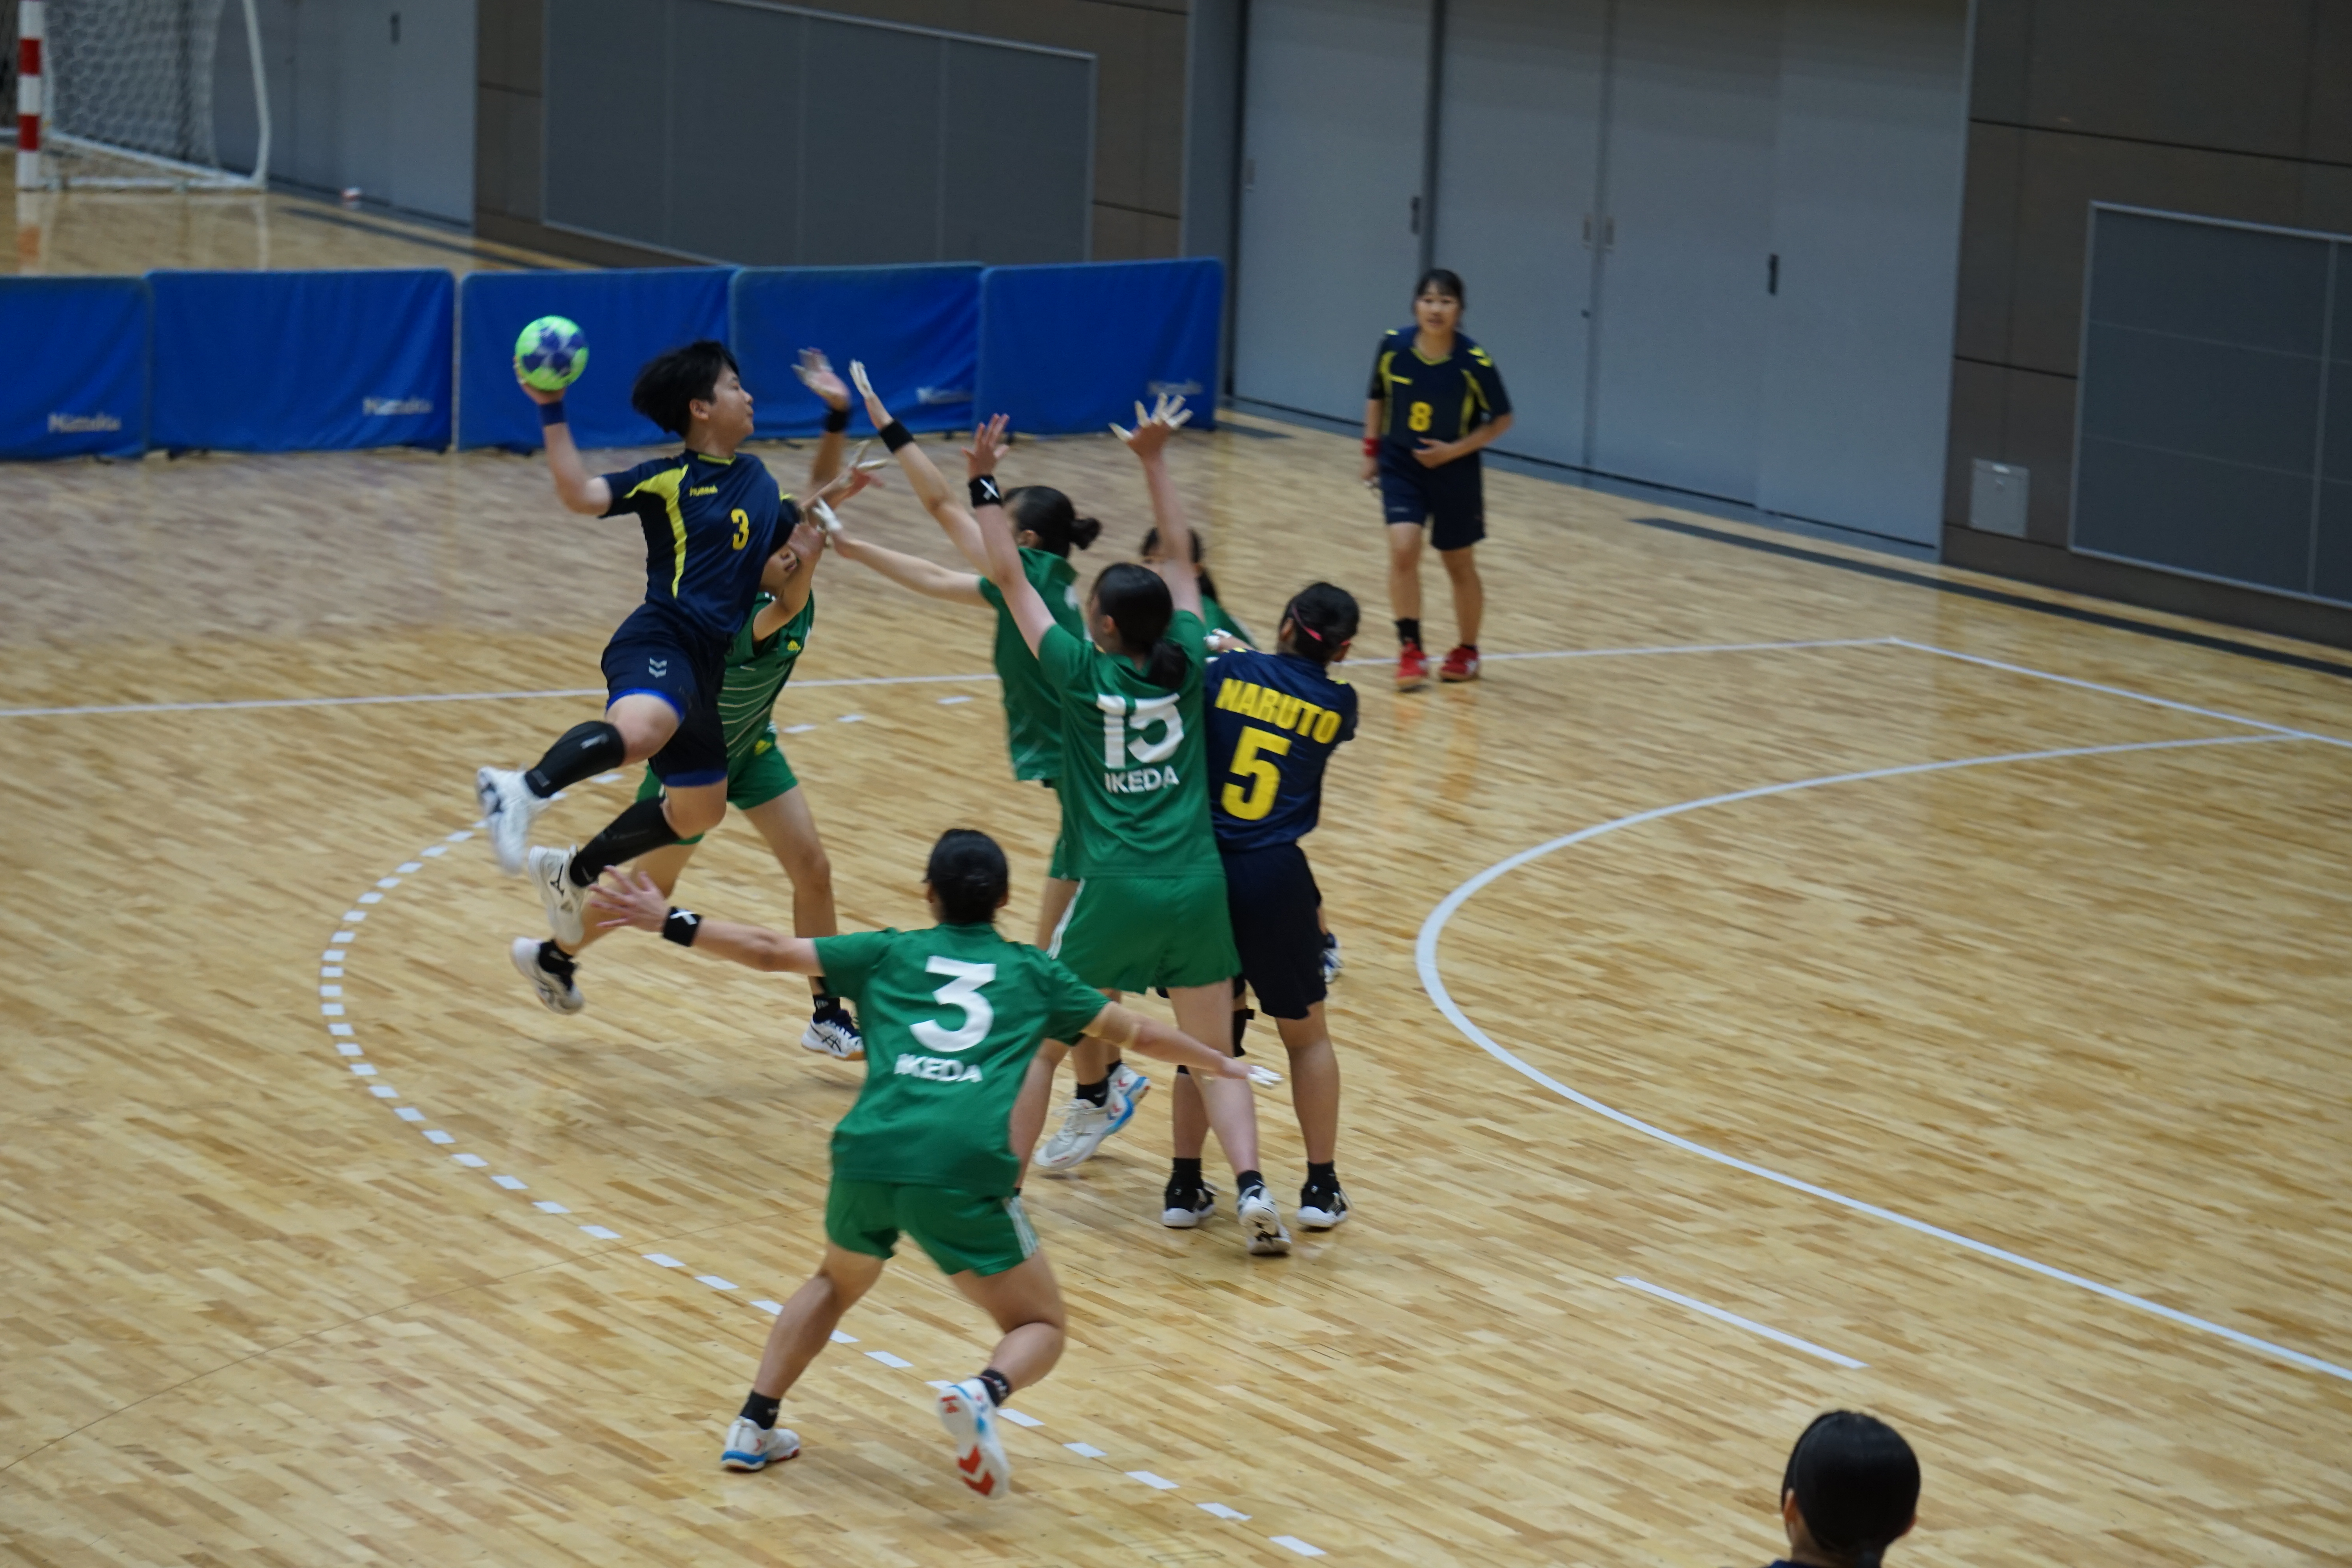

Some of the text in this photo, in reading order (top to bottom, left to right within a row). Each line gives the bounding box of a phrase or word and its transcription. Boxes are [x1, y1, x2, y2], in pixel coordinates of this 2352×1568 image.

[1407, 401, 1434, 432] 8
[731, 508, 750, 551] 3
[1096, 692, 1185, 769] 15
[1214, 677, 1343, 745] NARUTO
[1104, 765, 1180, 794] IKEDA
[1220, 726, 1292, 821] 5
[909, 955, 997, 1053] 3
[893, 1053, 984, 1083] IKEDA
